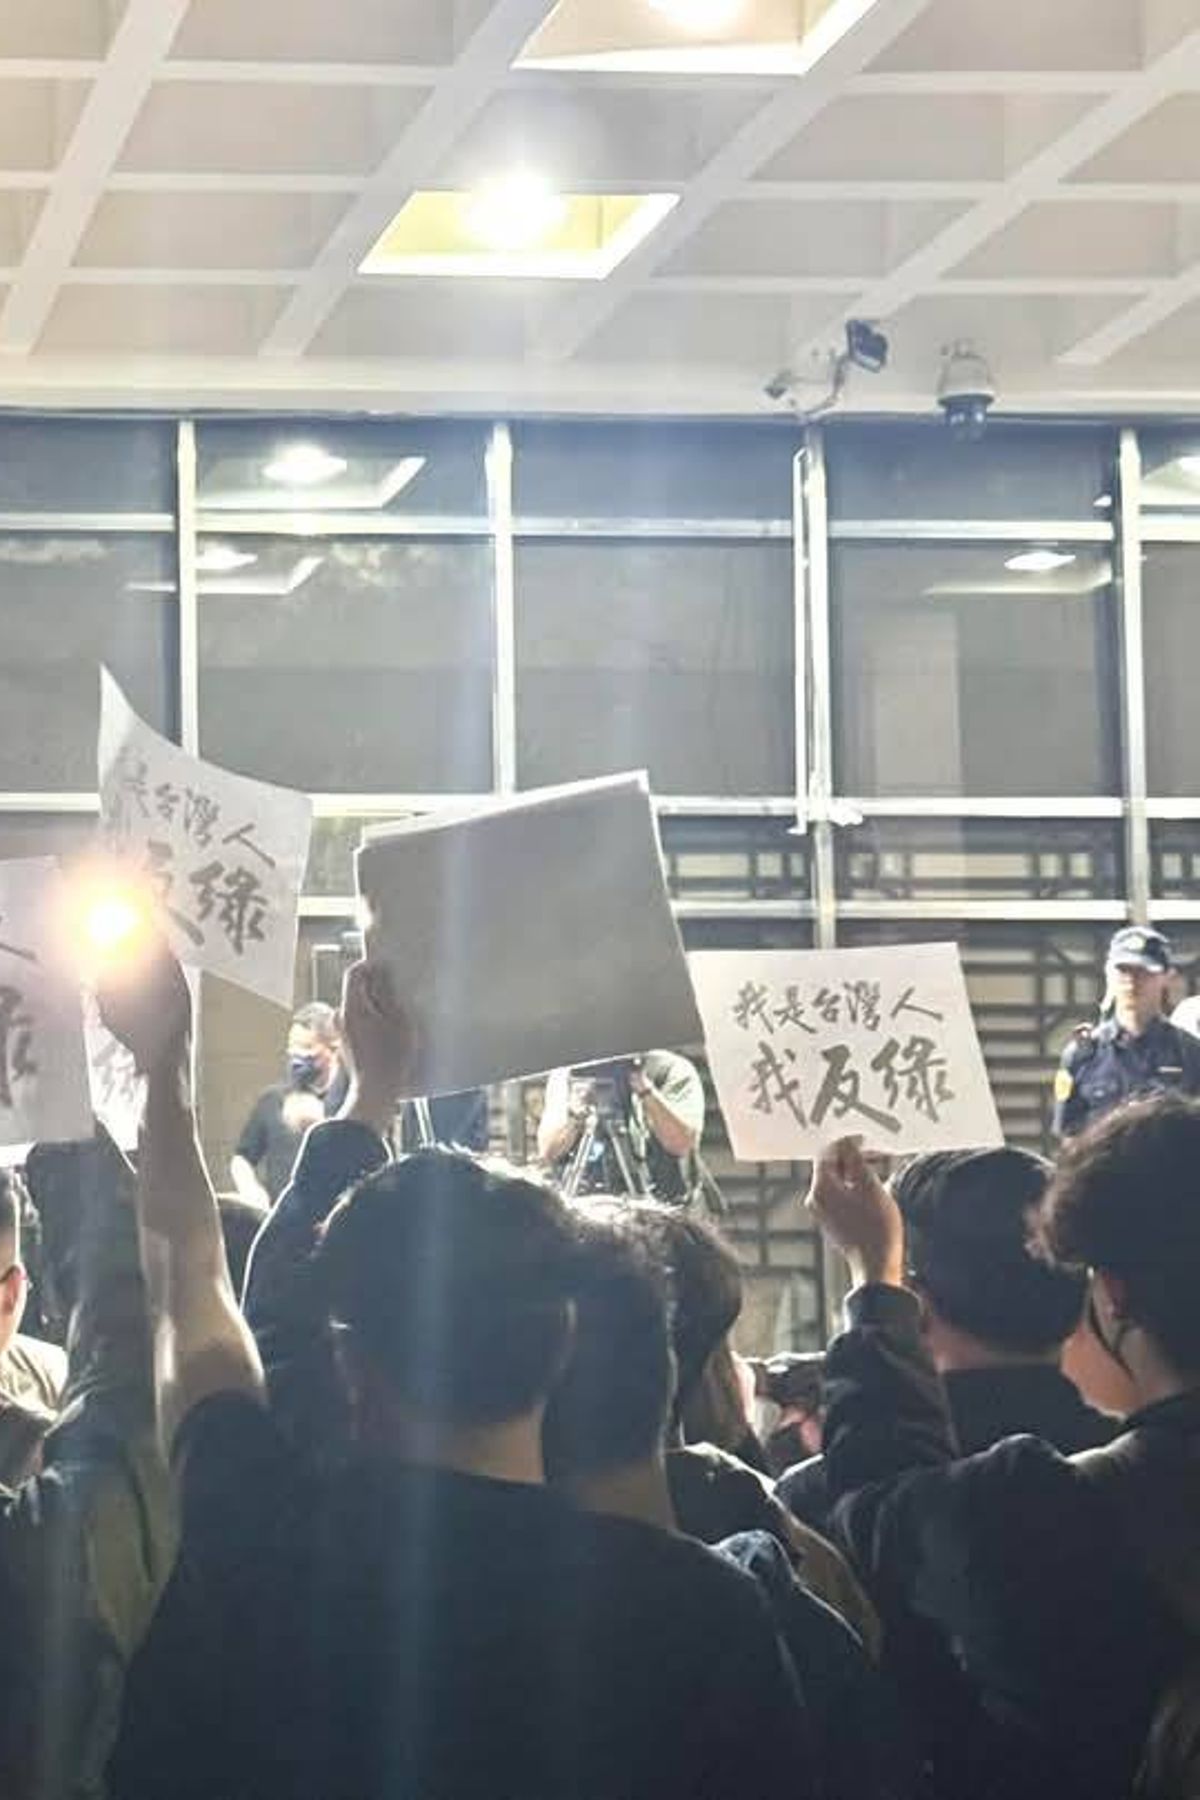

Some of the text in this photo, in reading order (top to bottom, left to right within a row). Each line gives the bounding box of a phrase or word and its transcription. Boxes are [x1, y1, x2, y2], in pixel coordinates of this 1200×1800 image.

[108, 748, 277, 868] 是台灣人
[732, 980, 943, 1034] 我是台灣人
[750, 1035, 955, 1133] 我反綠
